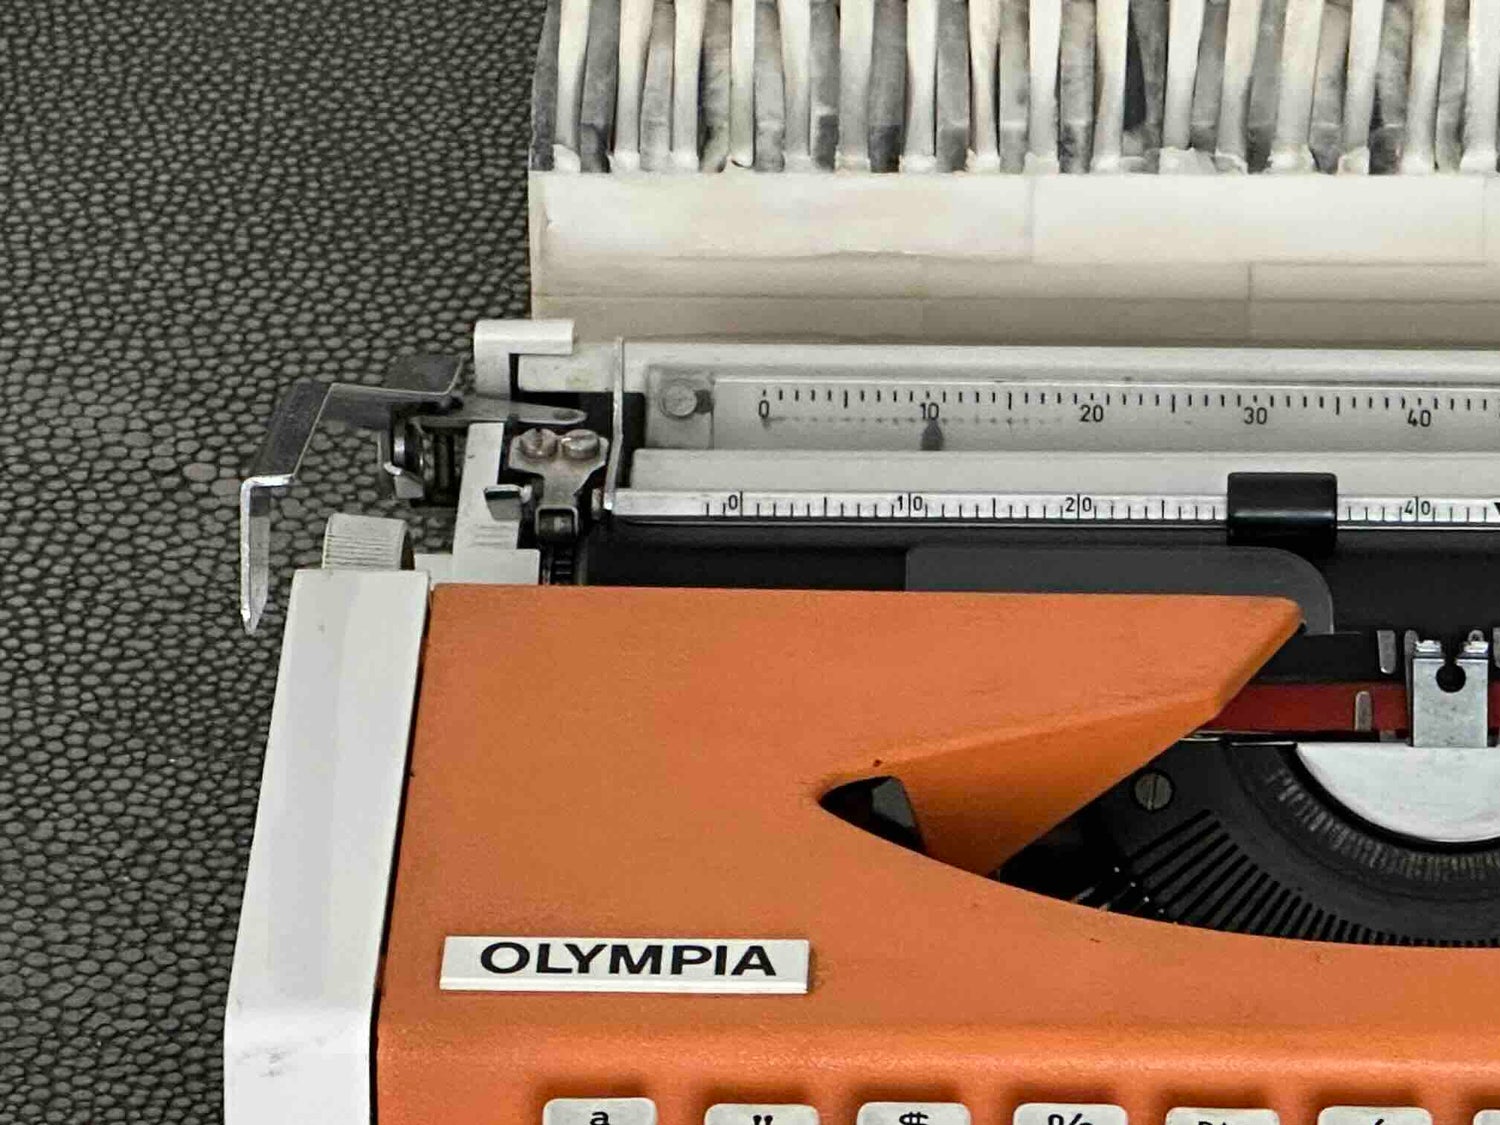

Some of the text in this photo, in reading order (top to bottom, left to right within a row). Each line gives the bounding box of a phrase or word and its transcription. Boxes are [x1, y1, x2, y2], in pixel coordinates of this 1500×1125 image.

[757, 403, 769, 420] 0
[920, 404, 939, 420] 10
[1080, 405, 1103, 422] 20
[1244, 408, 1267, 425] 30
[1408, 409, 1431, 427] 40
[480, 941, 777, 977] OLYMPIA
